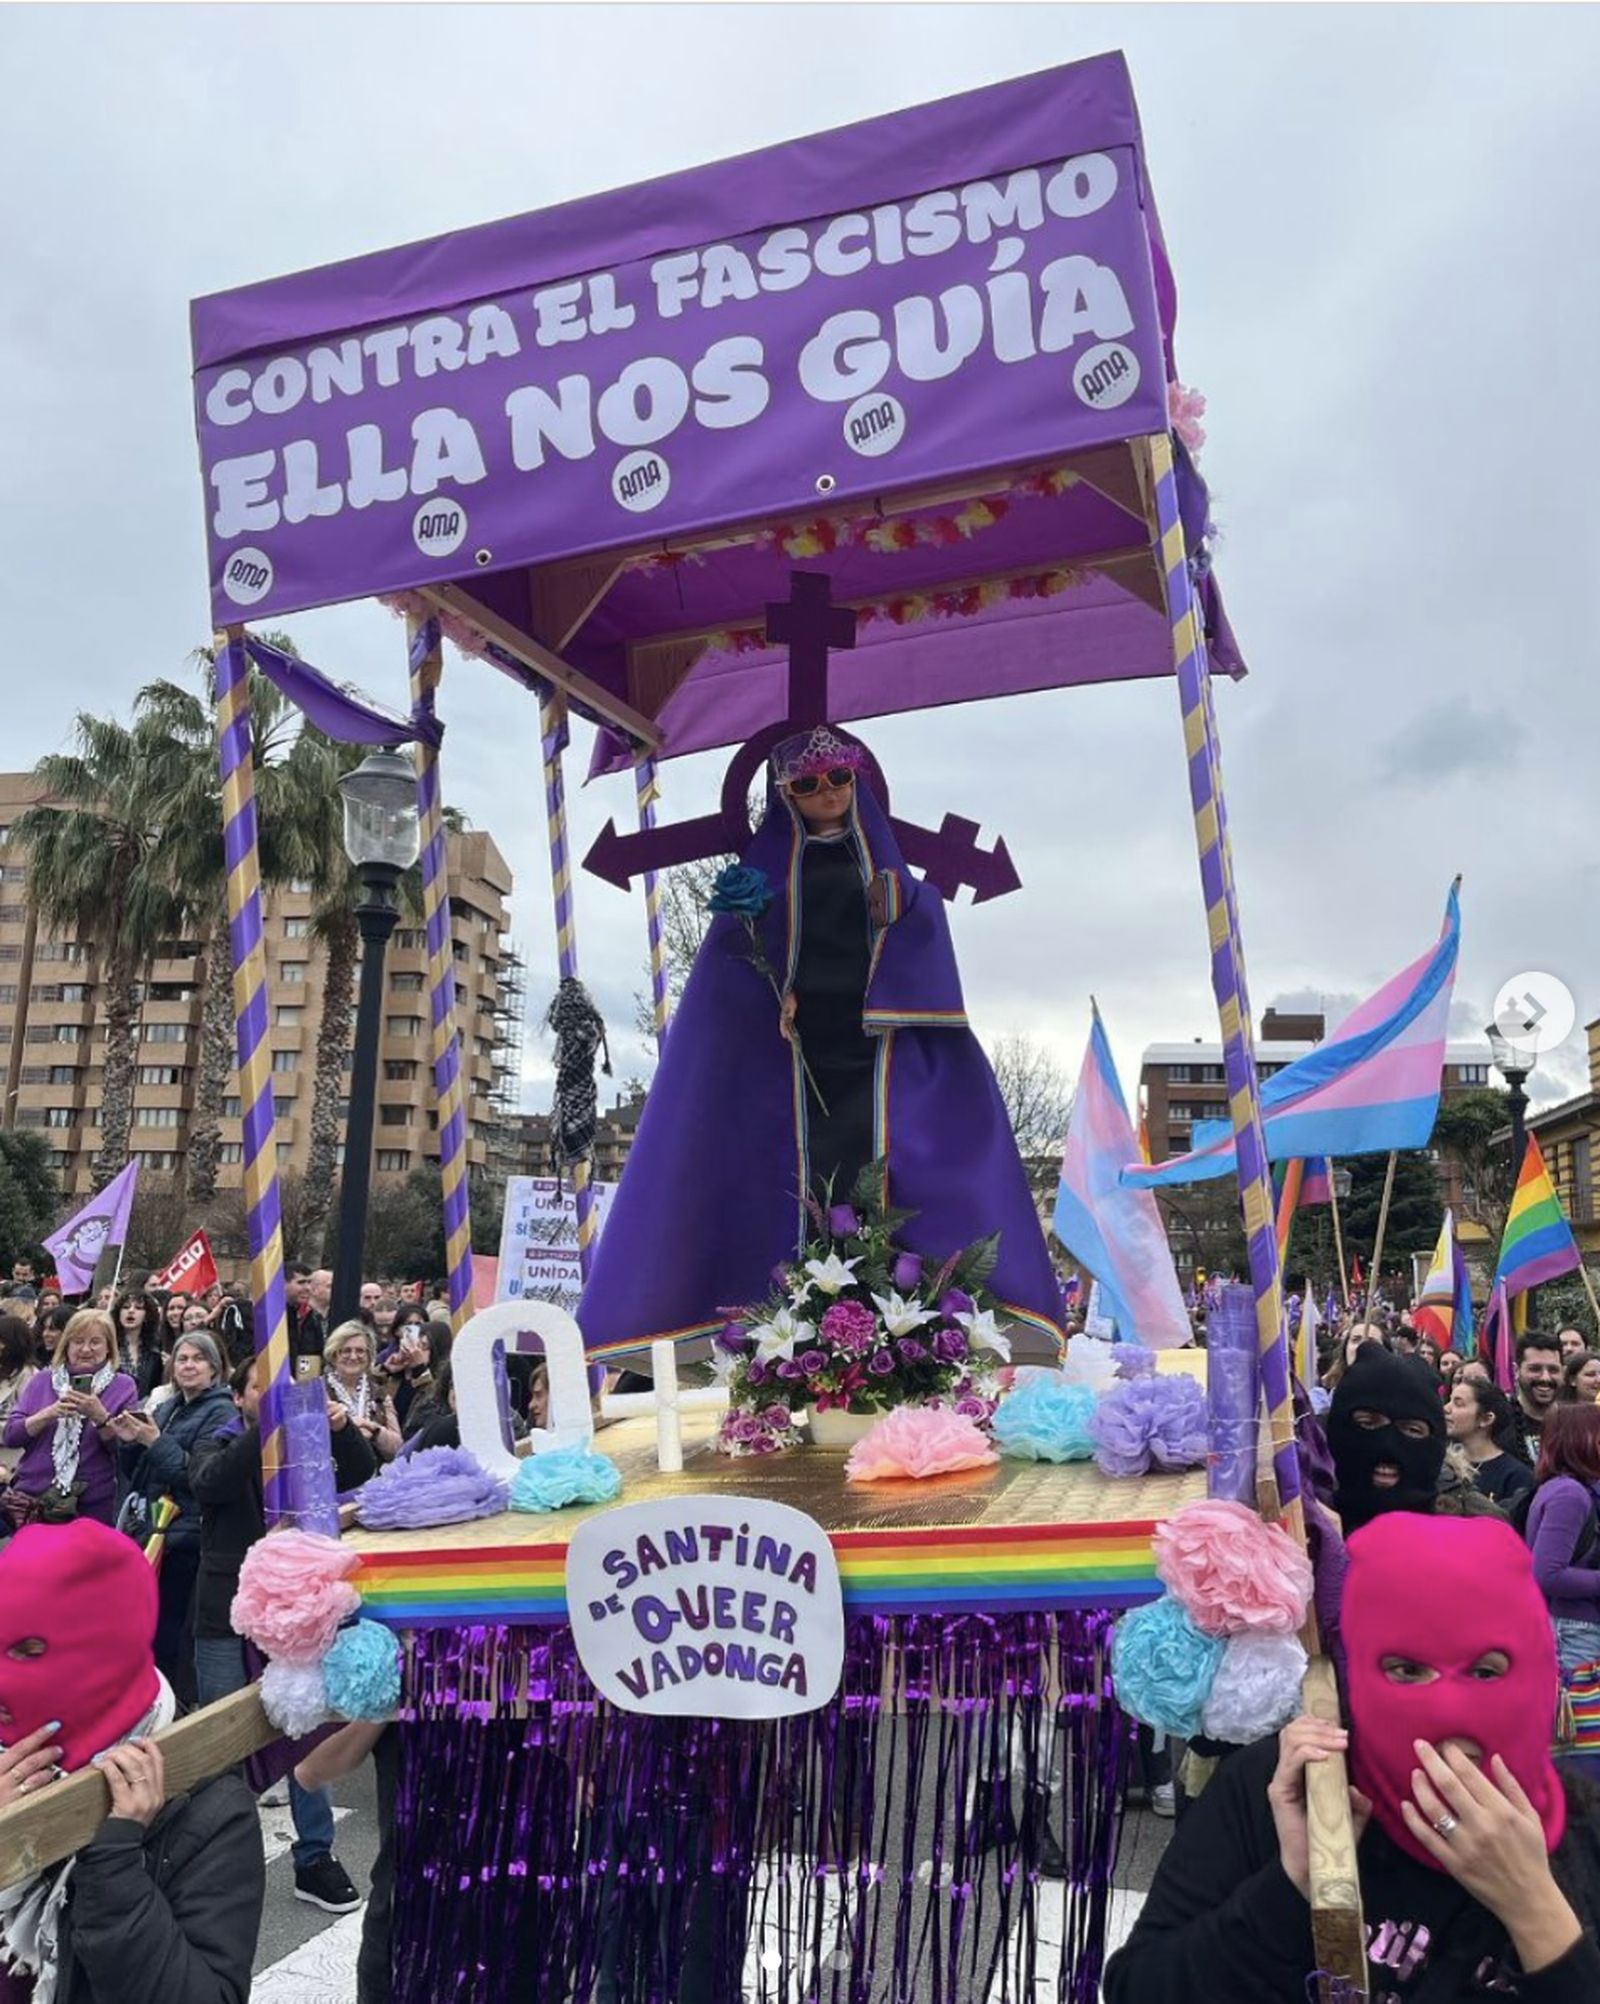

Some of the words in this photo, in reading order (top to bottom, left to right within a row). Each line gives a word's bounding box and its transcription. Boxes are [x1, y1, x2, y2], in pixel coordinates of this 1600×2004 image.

[205, 303, 521, 427] CONTRA
[533, 272, 637, 348] EL
[650, 152, 1119, 319] FASCISMO
[210, 406, 488, 539] ELLA
[504, 335, 771, 471] NOS
[798, 236, 1136, 403] GUÍA
[1081, 350, 1129, 401] AMA
[850, 400, 895, 445] AMA
[619, 459, 661, 501] AMA
[418, 511, 460, 540] AMA
[228, 558, 270, 591] AMA
[588, 1592, 626, 1622] DE
[631, 1584, 798, 1645] QUEER
[615, 1642, 808, 1700] VADONGA
